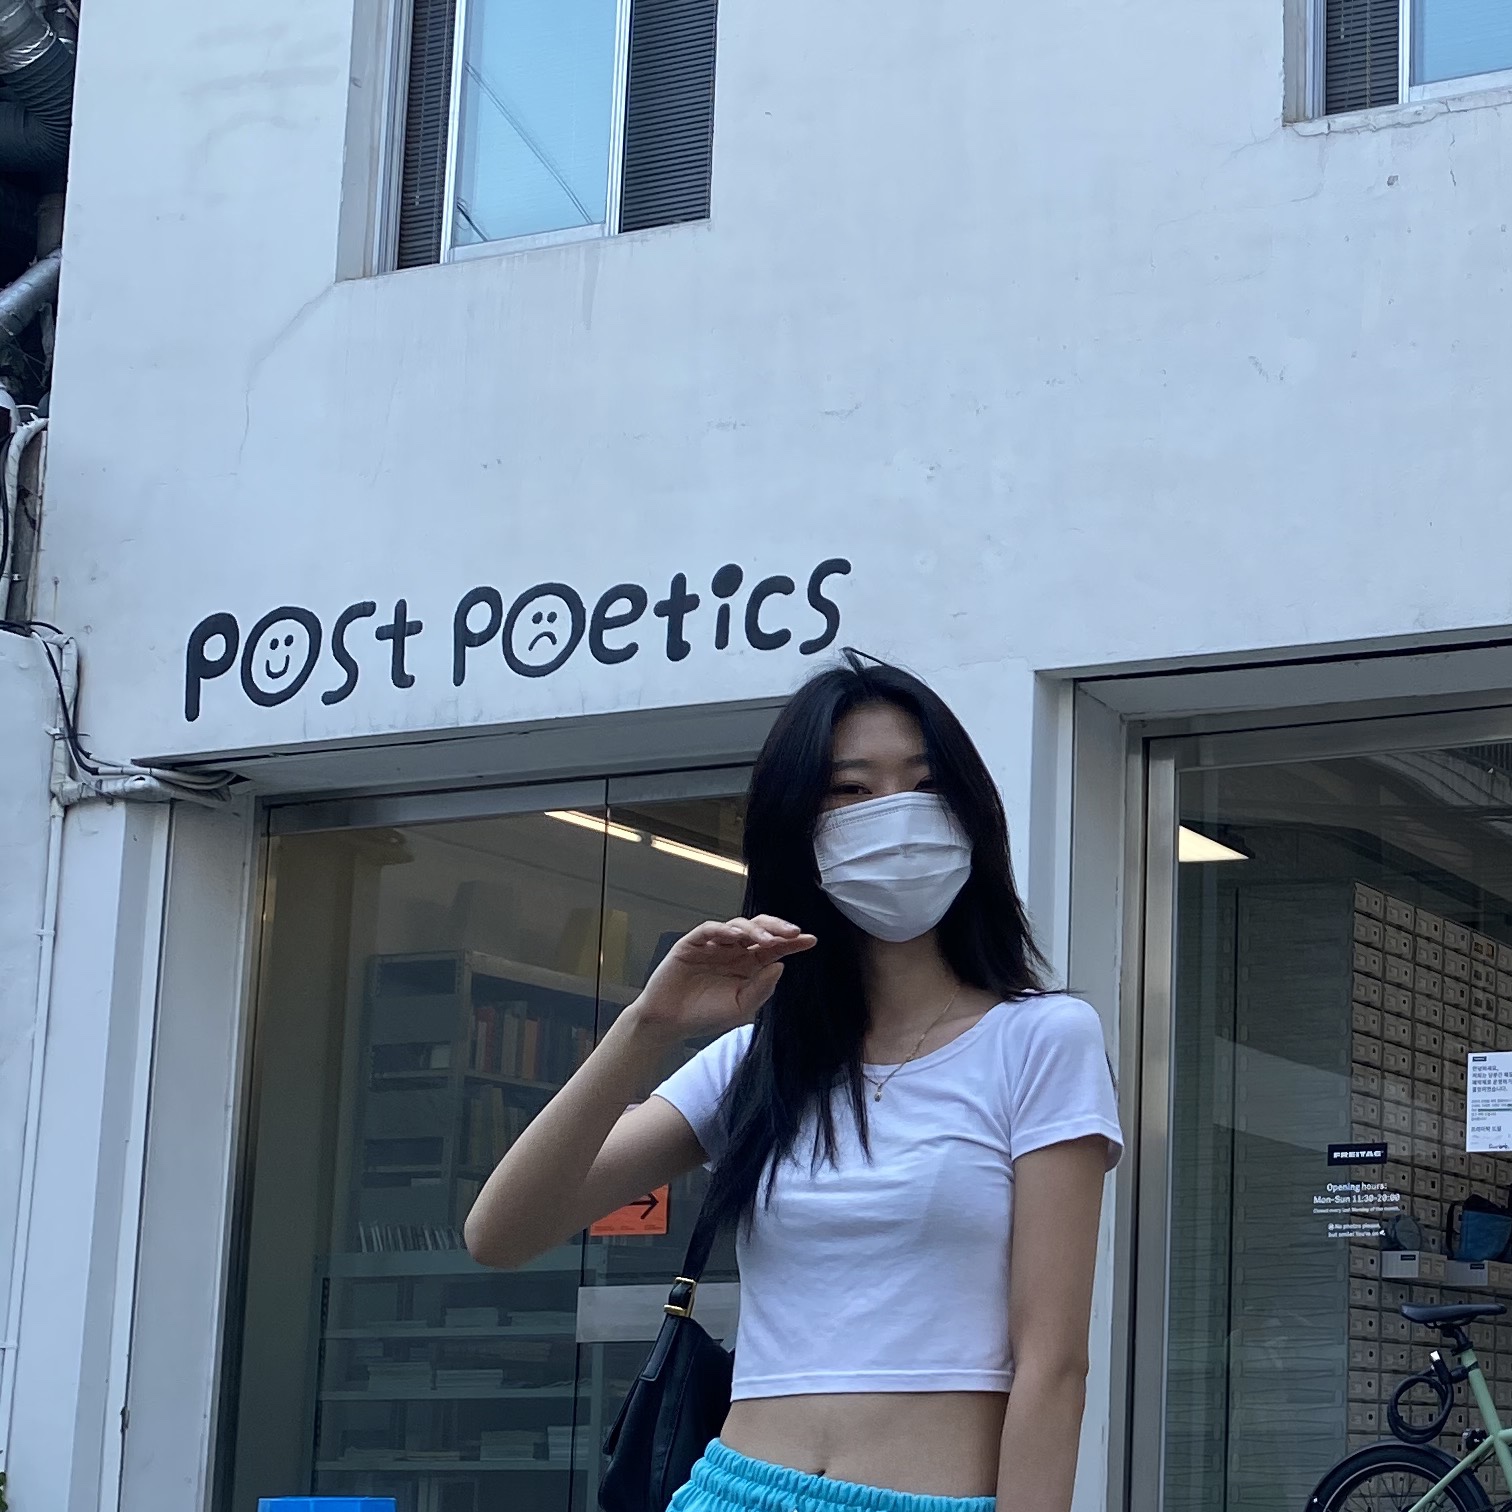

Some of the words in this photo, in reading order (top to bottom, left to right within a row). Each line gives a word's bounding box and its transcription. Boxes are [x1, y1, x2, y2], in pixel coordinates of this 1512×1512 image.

[1333, 1150, 1382, 1158] FREITAG
[1326, 1182, 1360, 1193] Opening
[1361, 1181, 1388, 1190] hours:
[1313, 1195, 1350, 1204] Mon-Sun
